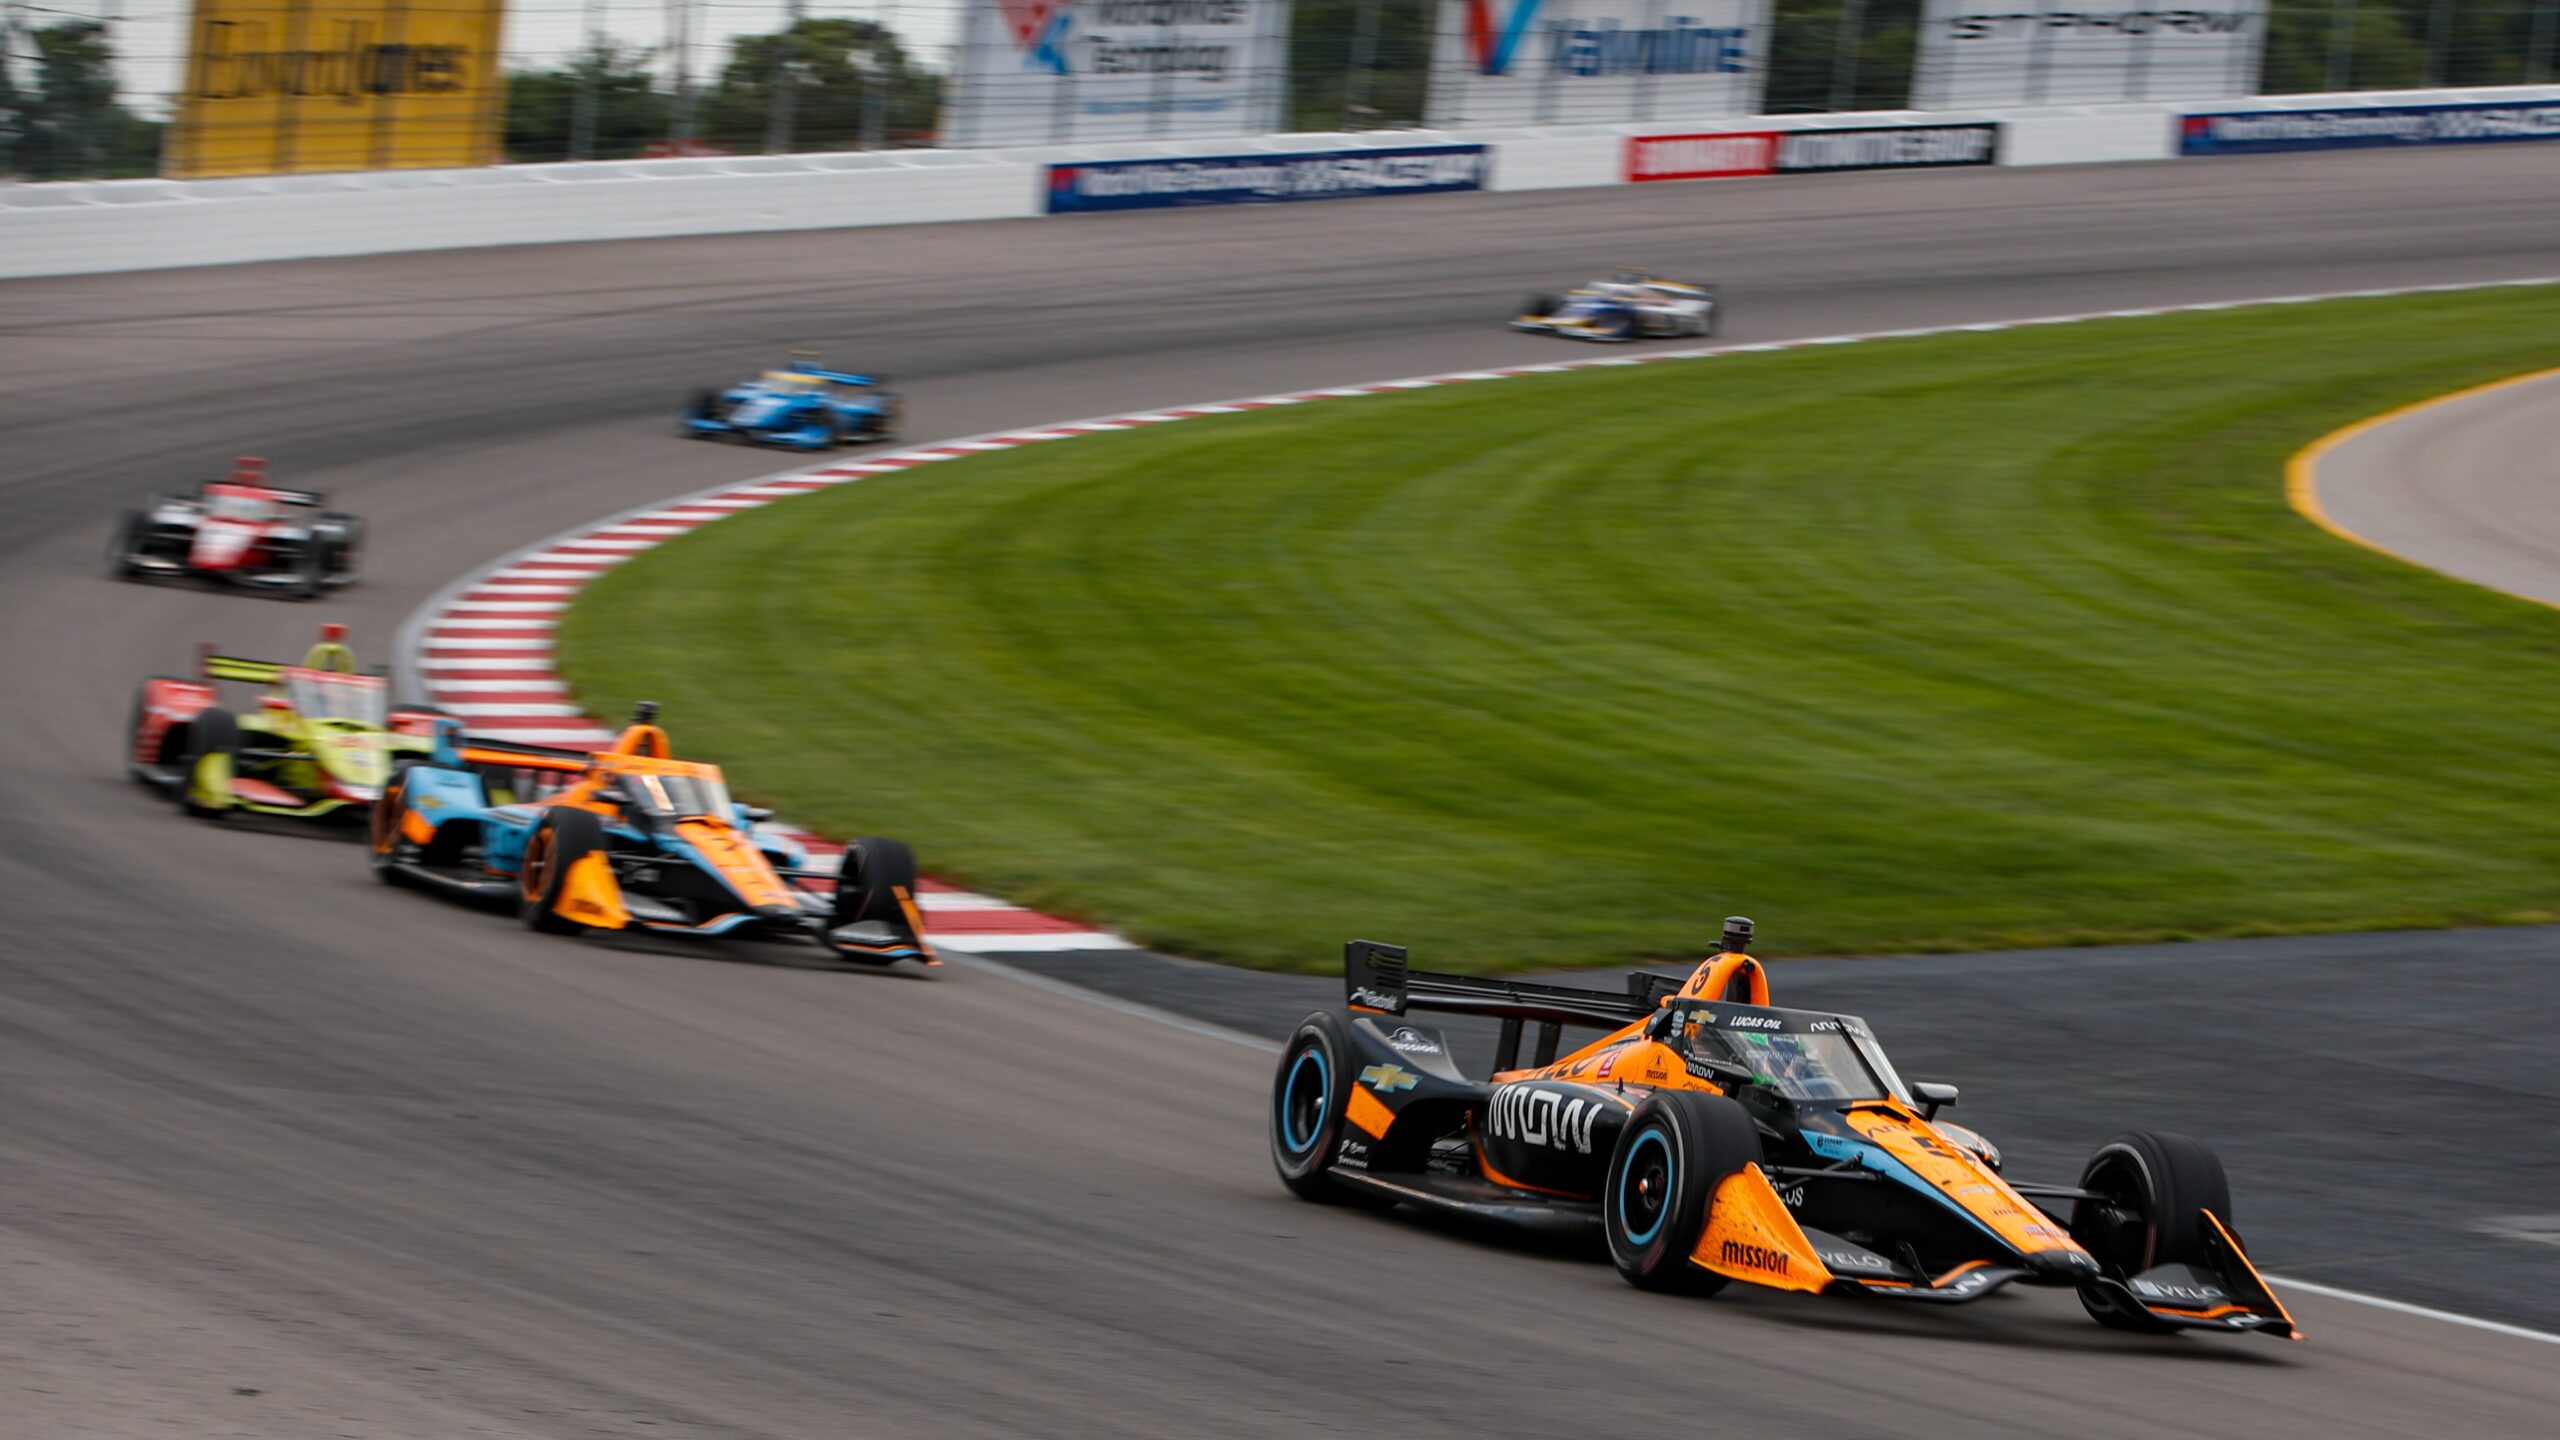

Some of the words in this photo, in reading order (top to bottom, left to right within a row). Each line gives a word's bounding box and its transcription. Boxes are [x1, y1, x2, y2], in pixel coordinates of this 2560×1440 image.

[1690, 956, 1722, 995] 5
[1729, 1015, 1765, 1028] LUCAS
[1764, 1018, 1783, 1030] OIL
[1818, 1251, 1882, 1269] VELO
